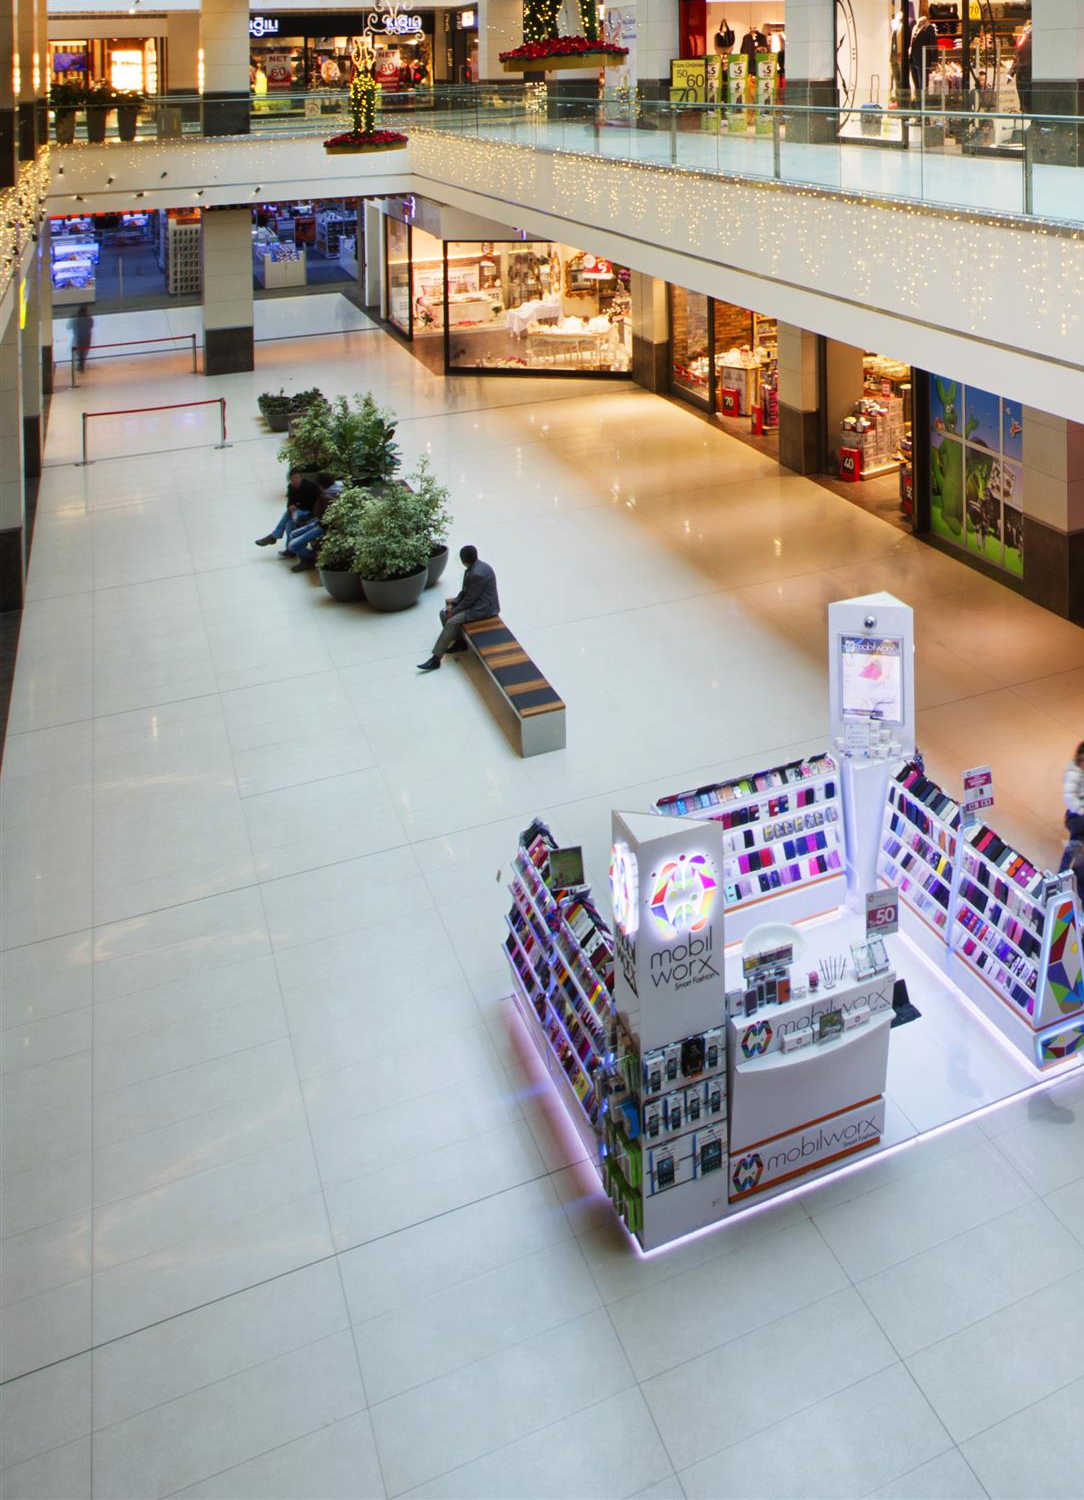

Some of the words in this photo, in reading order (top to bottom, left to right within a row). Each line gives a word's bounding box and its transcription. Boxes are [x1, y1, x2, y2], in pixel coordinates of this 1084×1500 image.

[677, 70, 687, 78] 50
[686, 73, 705, 88] 60
[670, 88, 698, 103] 70
[651, 925, 713, 970] mobil
[651, 955, 720, 988] worx
[767, 1115, 881, 1171] mobilworx
